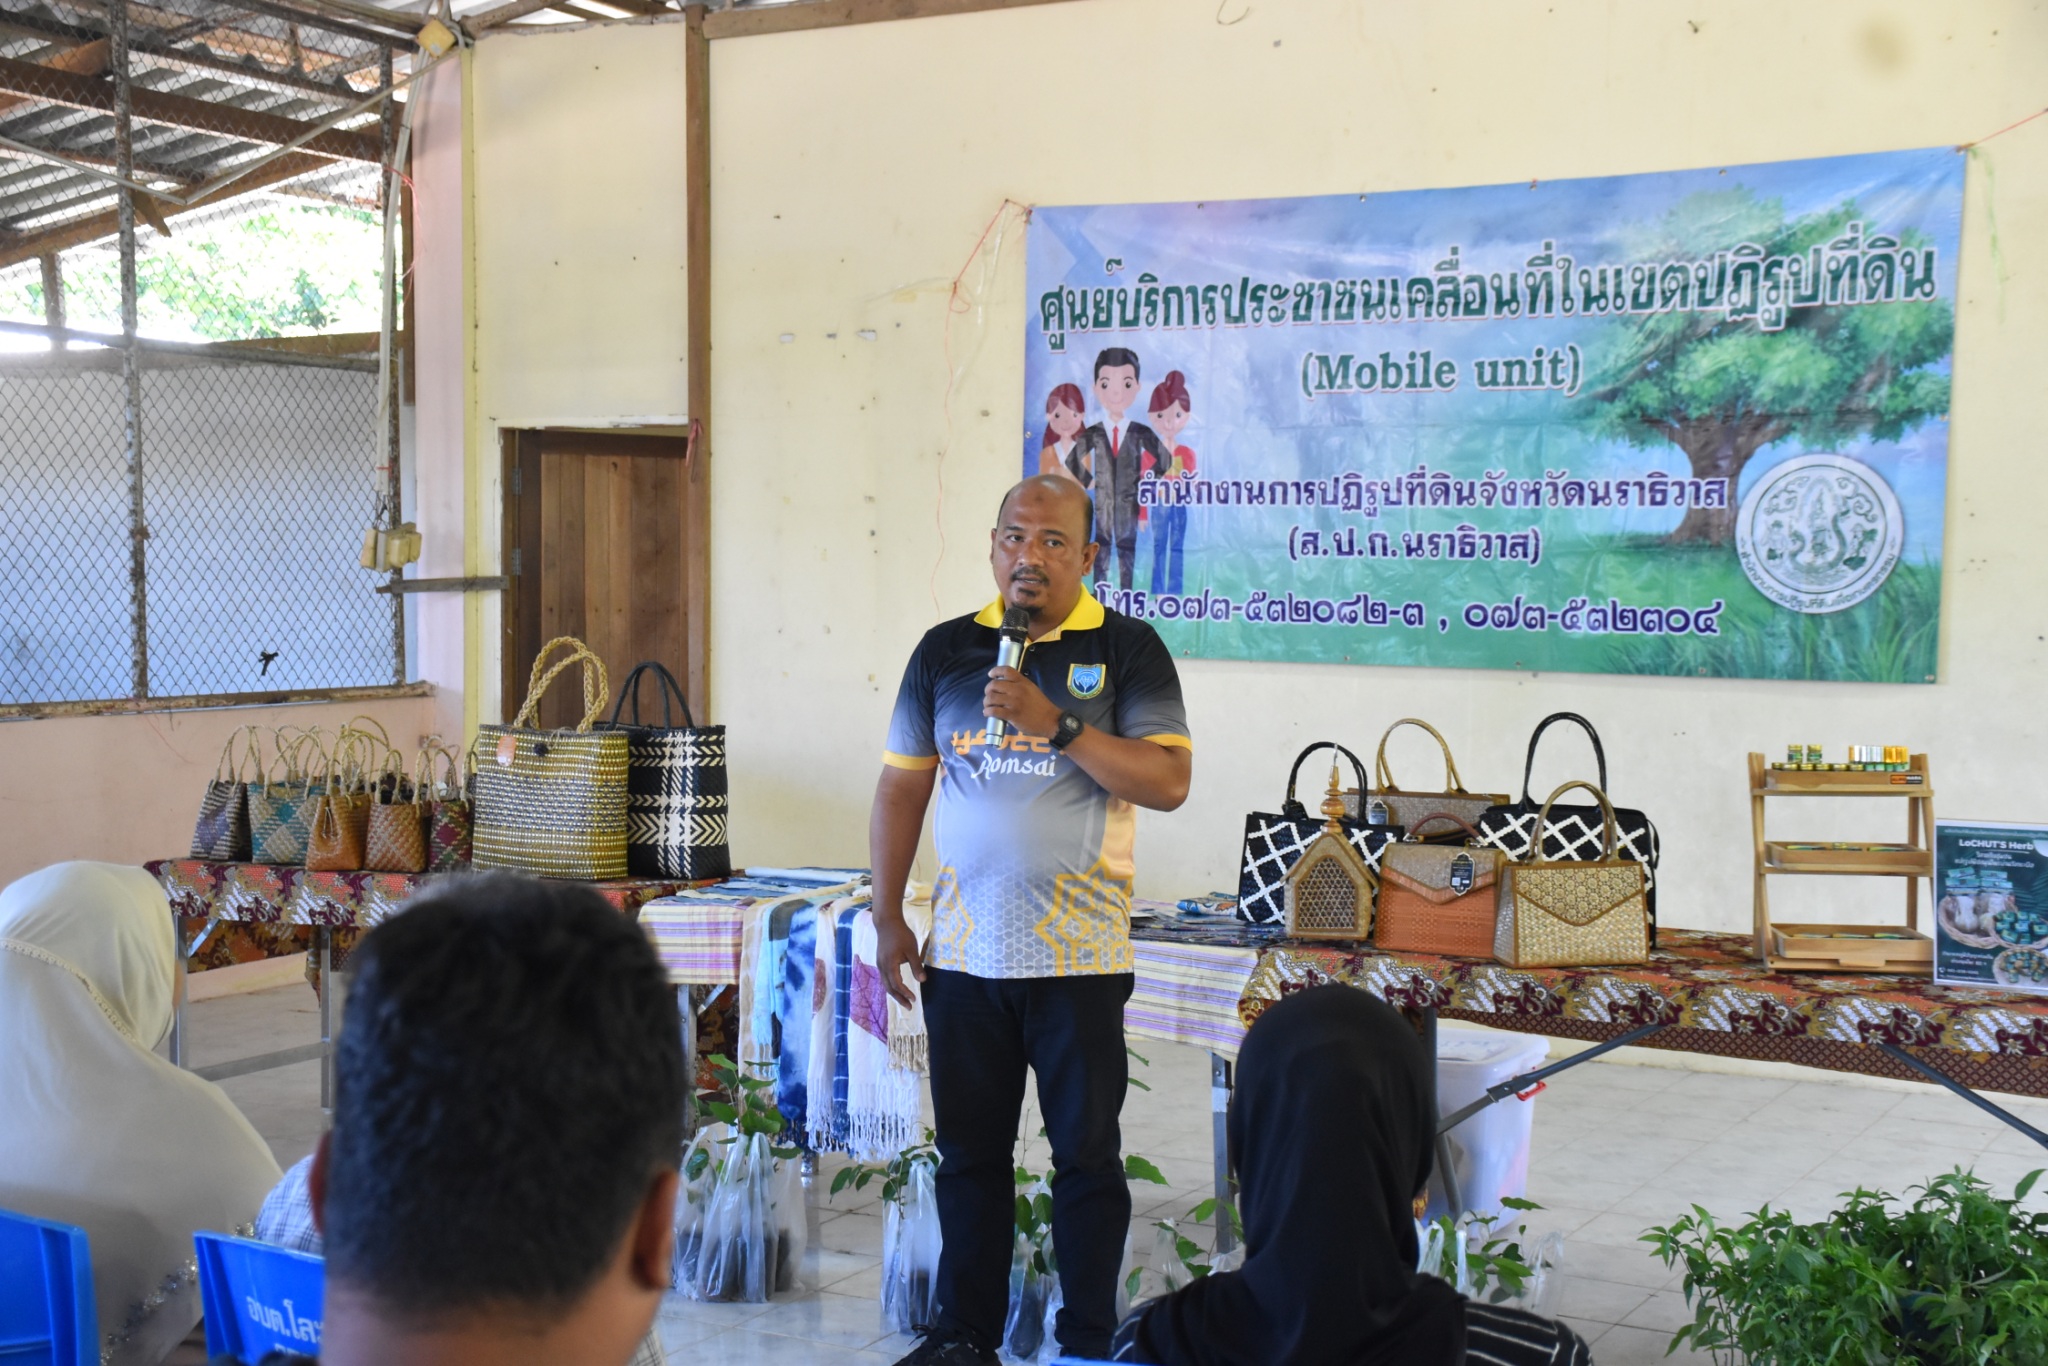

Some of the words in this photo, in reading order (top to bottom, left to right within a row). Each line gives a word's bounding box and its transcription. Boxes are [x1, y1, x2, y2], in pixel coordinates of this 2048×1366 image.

[1040, 222, 1936, 350] ศูนย์บริการประชาชนเคลื่อนที่ในเขตปฏิรูปที่ดิน
[1301, 351, 1456, 398] (Mobile
[1474, 345, 1580, 394] unit)
[1138, 465, 1727, 517] สำนักงานการปฏิรูปที่ดินจังหวัดนราธิวาส
[1289, 525, 1542, 566] (ส.ป.ก.นราธิวาส)
[1464, 596, 1723, 633] ๐๗๓-๕๓๒๓๐๔
[2008, 841, 2034, 851] Herb
